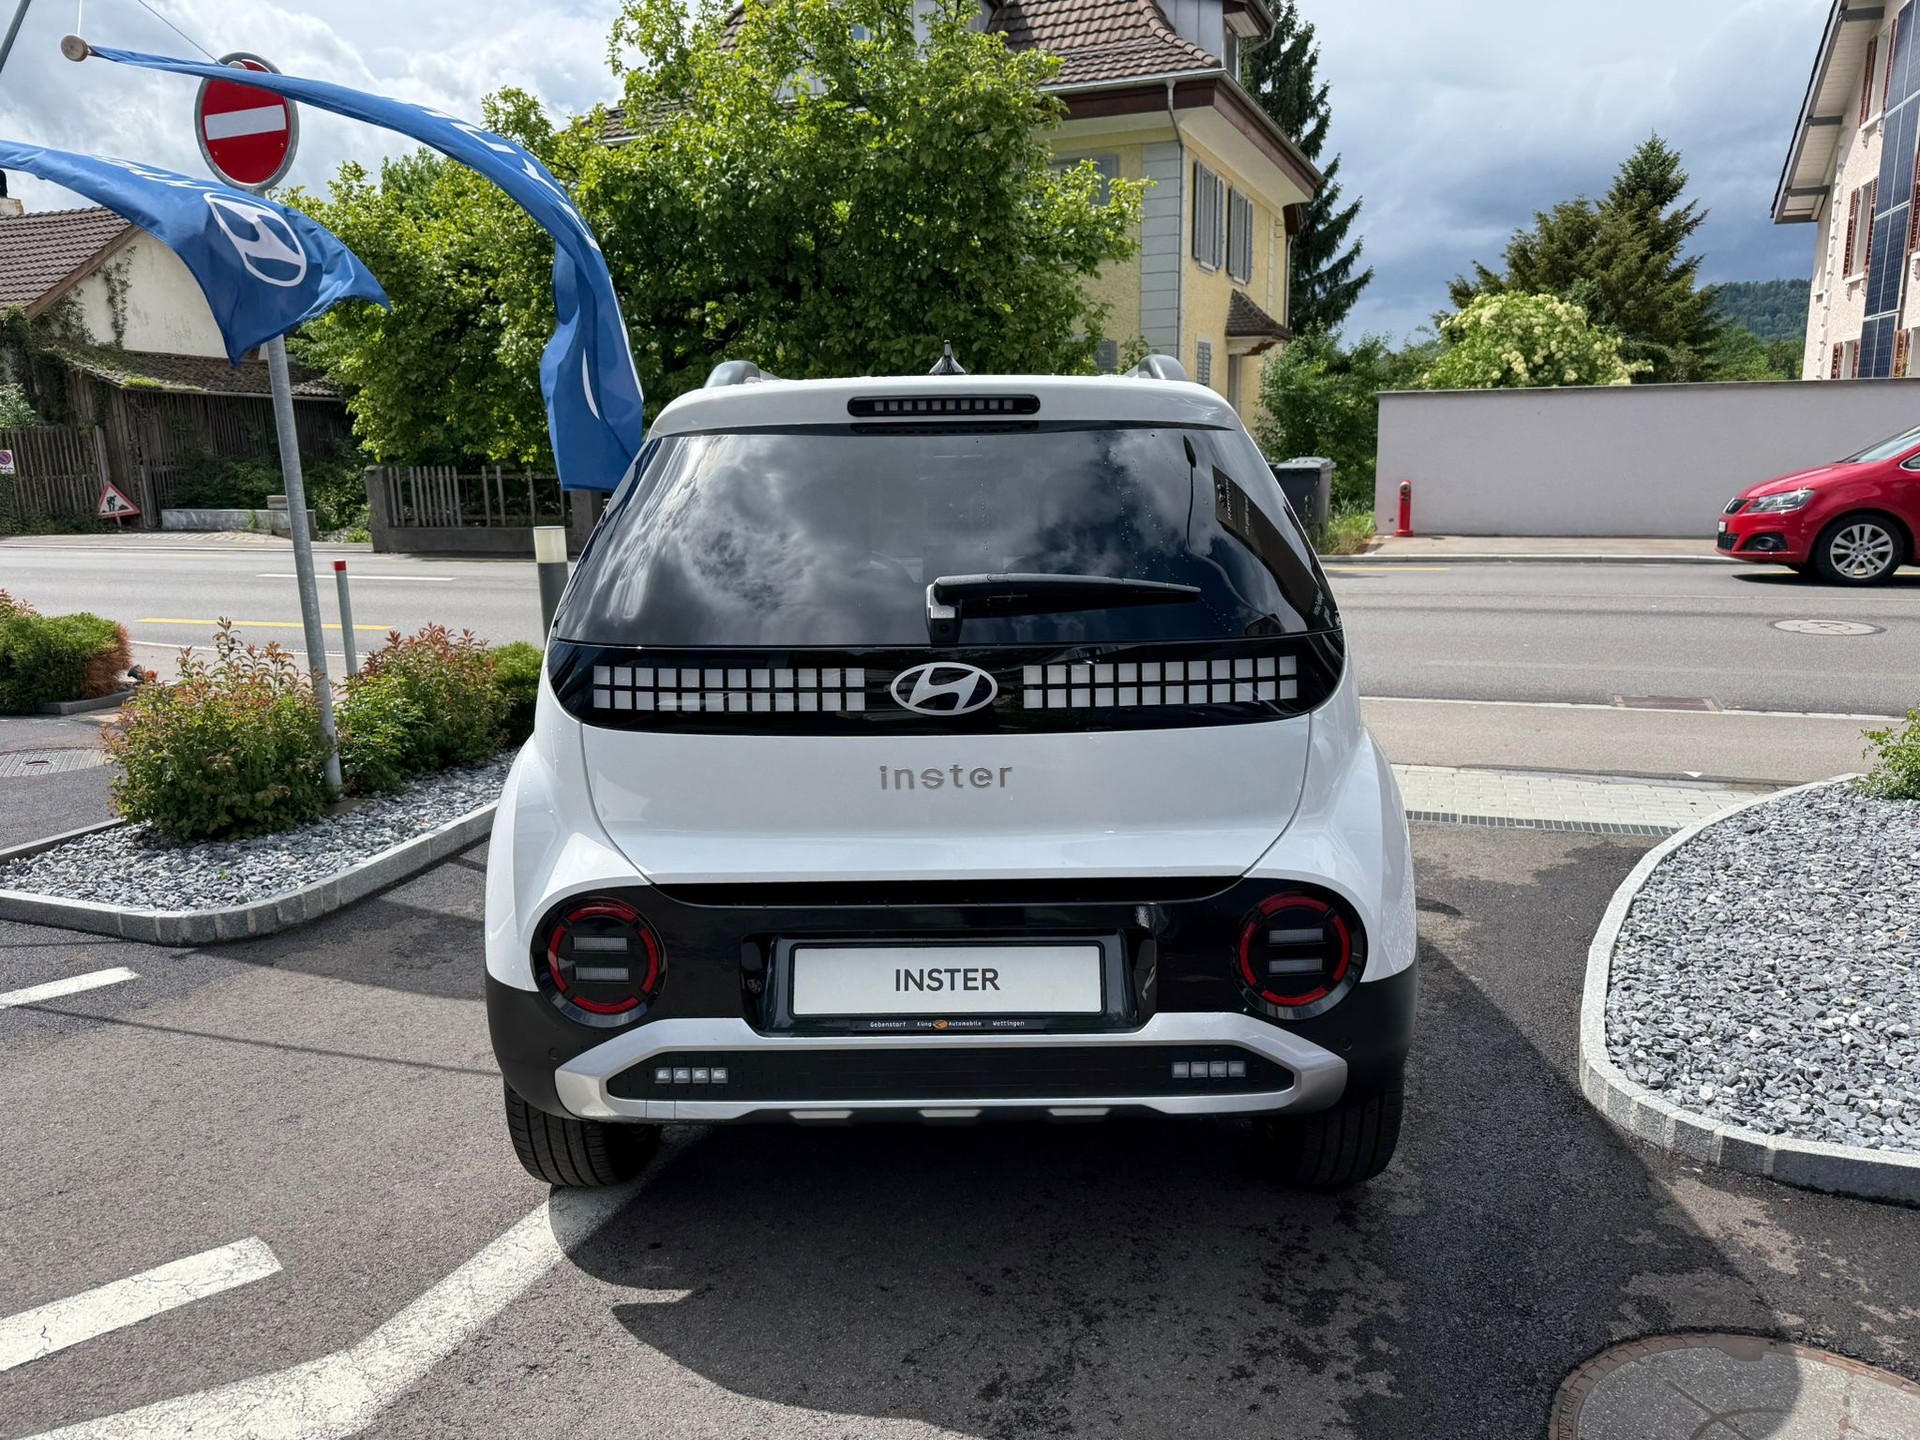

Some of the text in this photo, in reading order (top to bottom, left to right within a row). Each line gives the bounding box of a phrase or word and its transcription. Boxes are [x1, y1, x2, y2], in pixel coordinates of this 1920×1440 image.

[879, 764, 1013, 790] inster
[895, 968, 1001, 991] INSTER
[992, 1020, 1025, 1028] Wettingen
